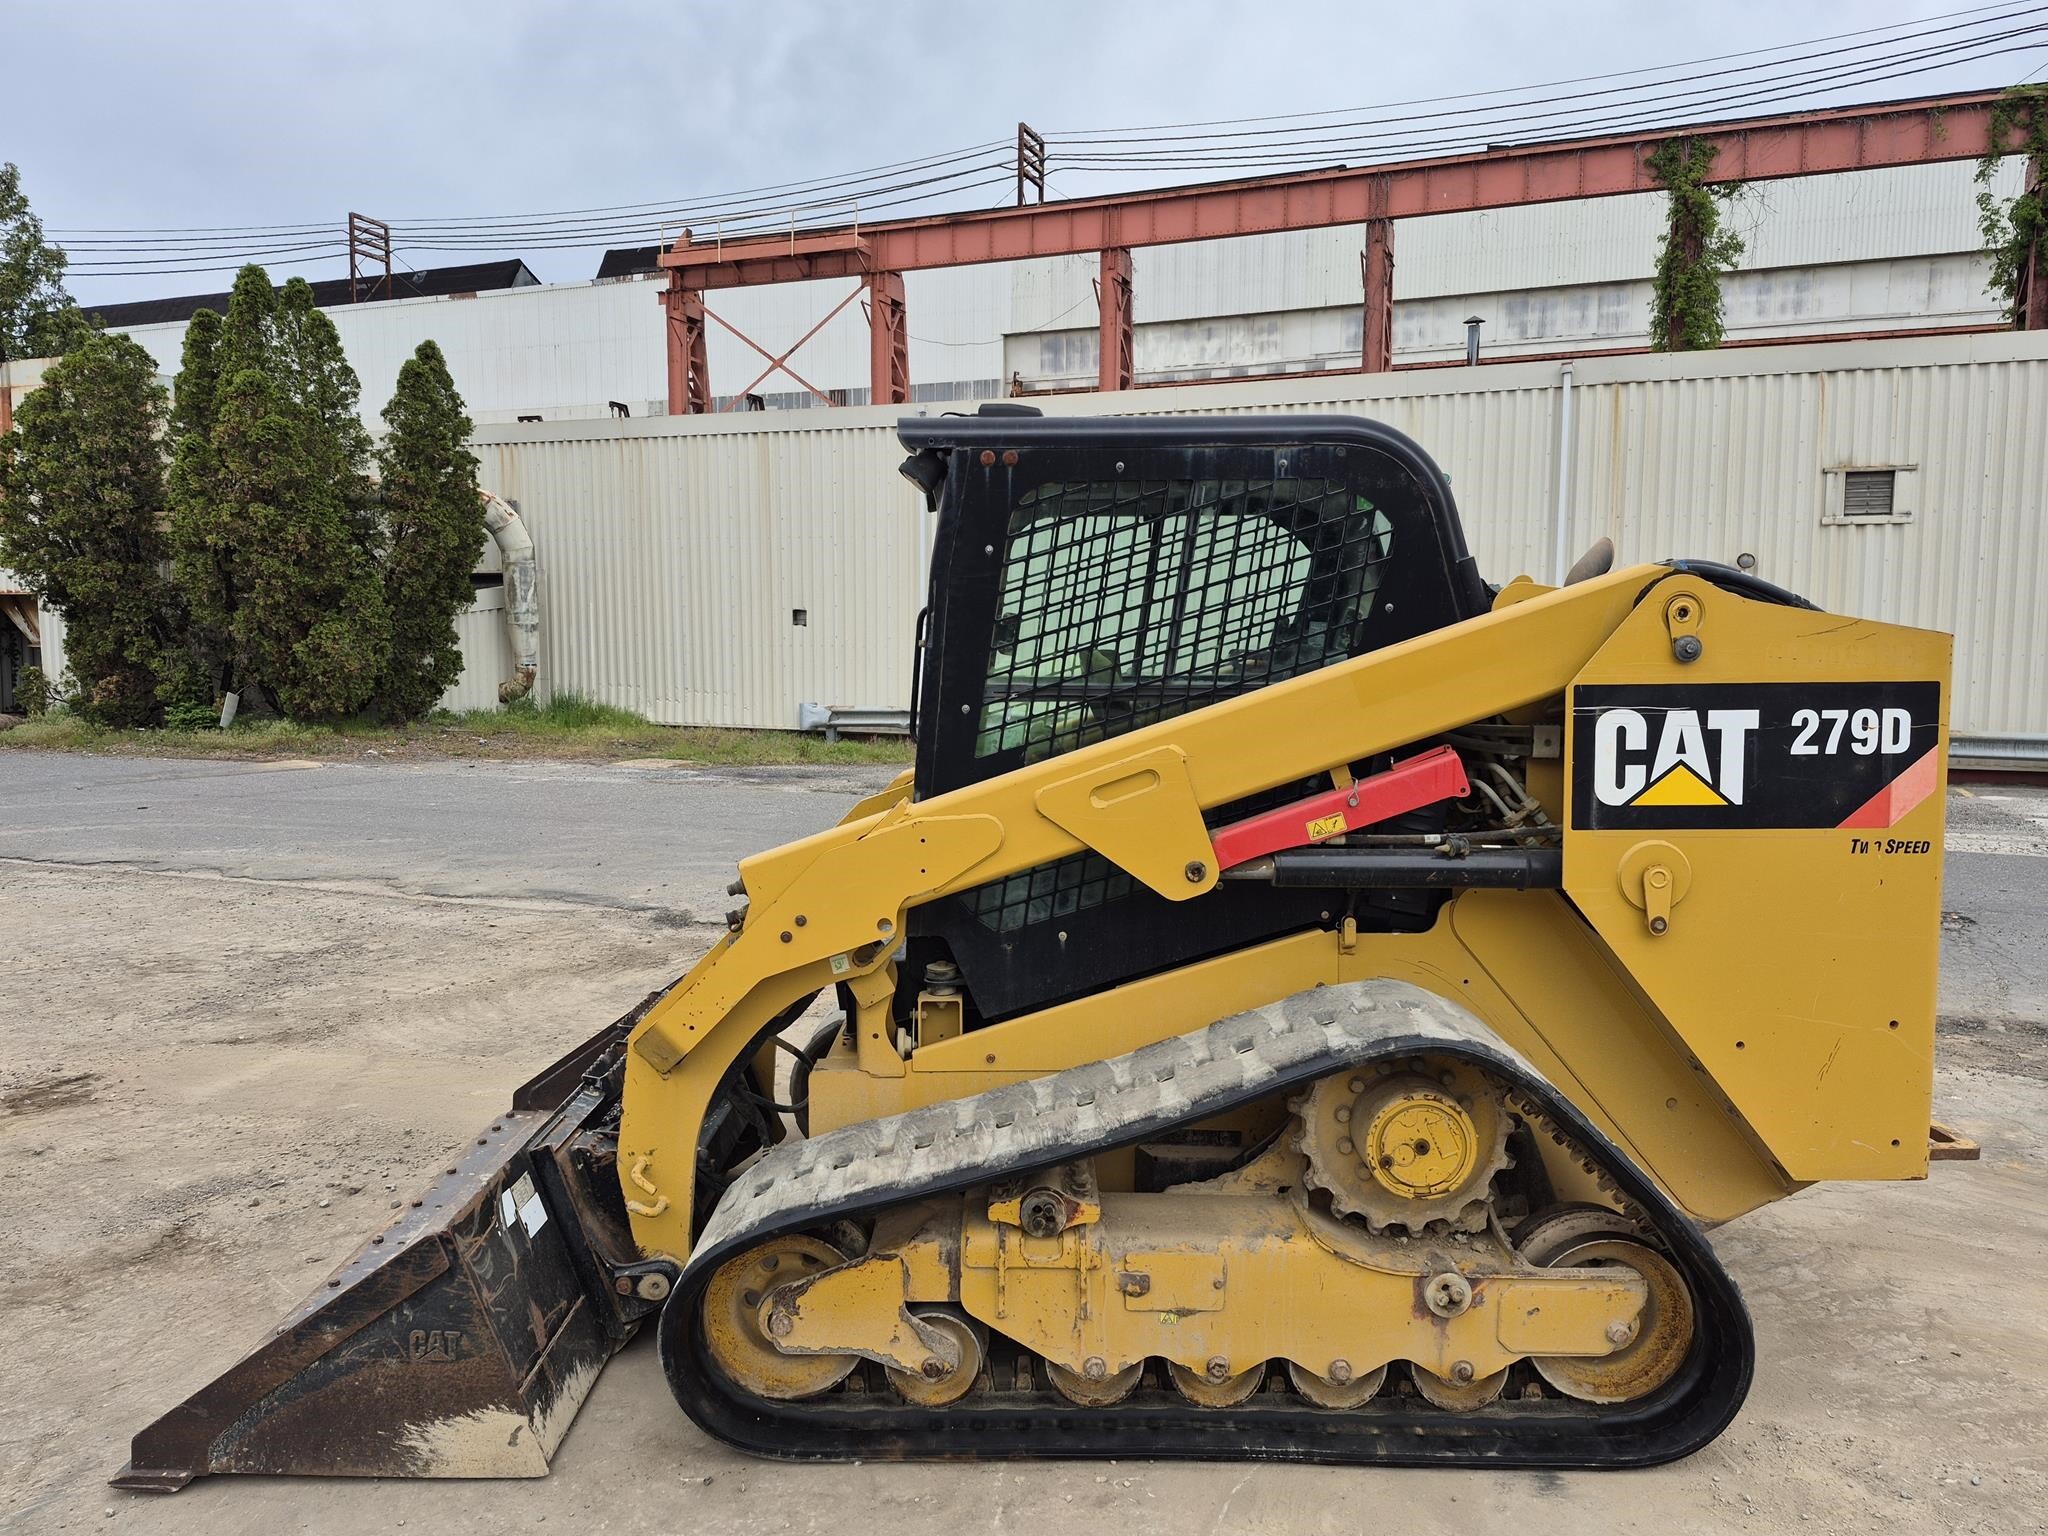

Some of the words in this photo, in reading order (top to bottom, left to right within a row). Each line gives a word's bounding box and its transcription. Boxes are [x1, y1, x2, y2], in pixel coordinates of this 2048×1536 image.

[1790, 708, 1912, 755] 279D
[1594, 709, 1760, 806] CAT
[1885, 838, 1931, 854] SPEED
[409, 1329, 462, 1361] CAT
